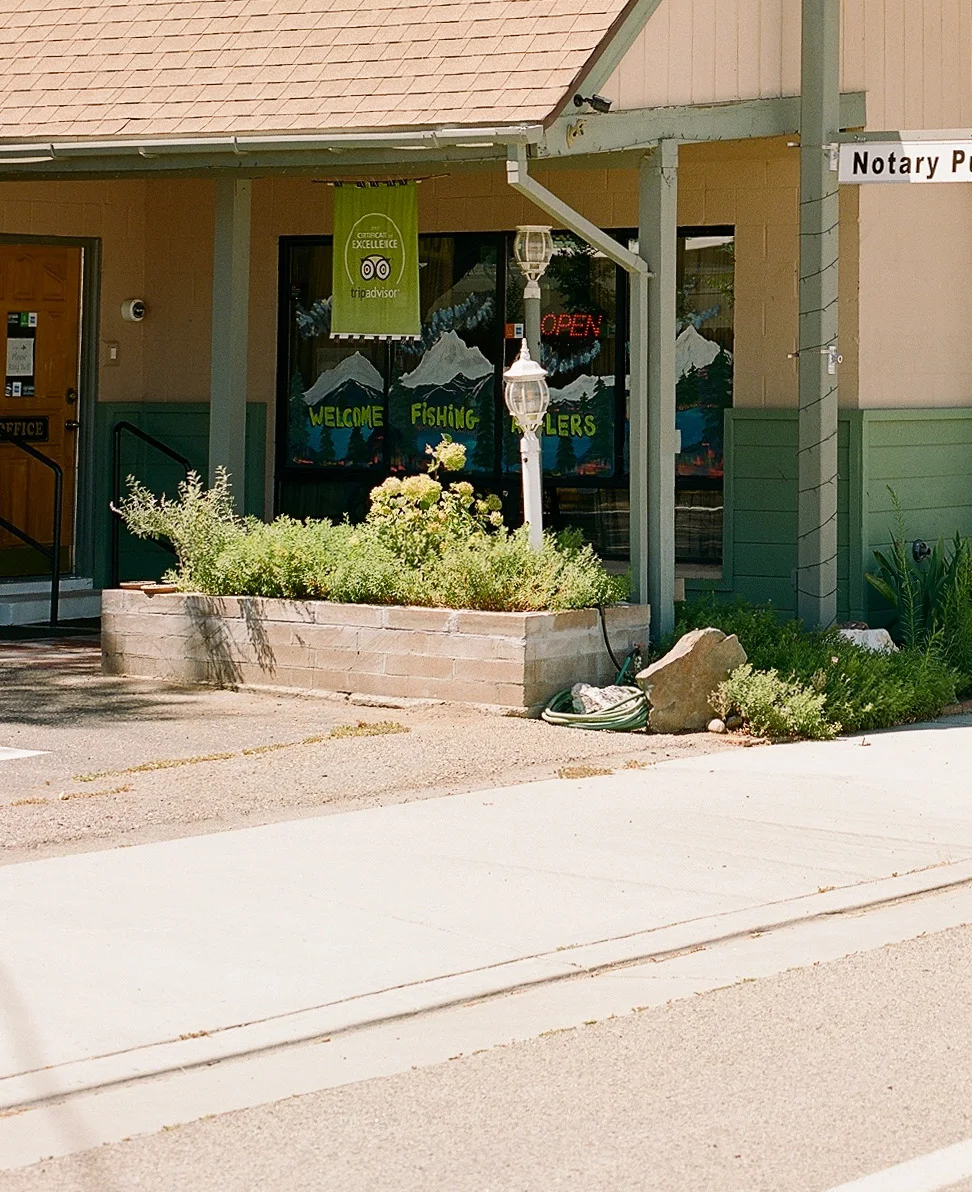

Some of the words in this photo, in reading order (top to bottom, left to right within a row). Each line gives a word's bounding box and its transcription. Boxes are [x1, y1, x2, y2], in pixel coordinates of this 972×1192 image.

[852, 151, 940, 180] Notary
[351, 239, 398, 249] EXCELLENCE
[350, 286, 398, 301] tripadvisor
[541, 313, 602, 337] OPEN
[308, 405, 384, 429] WELCOME
[511, 412, 597, 437] ALERS
